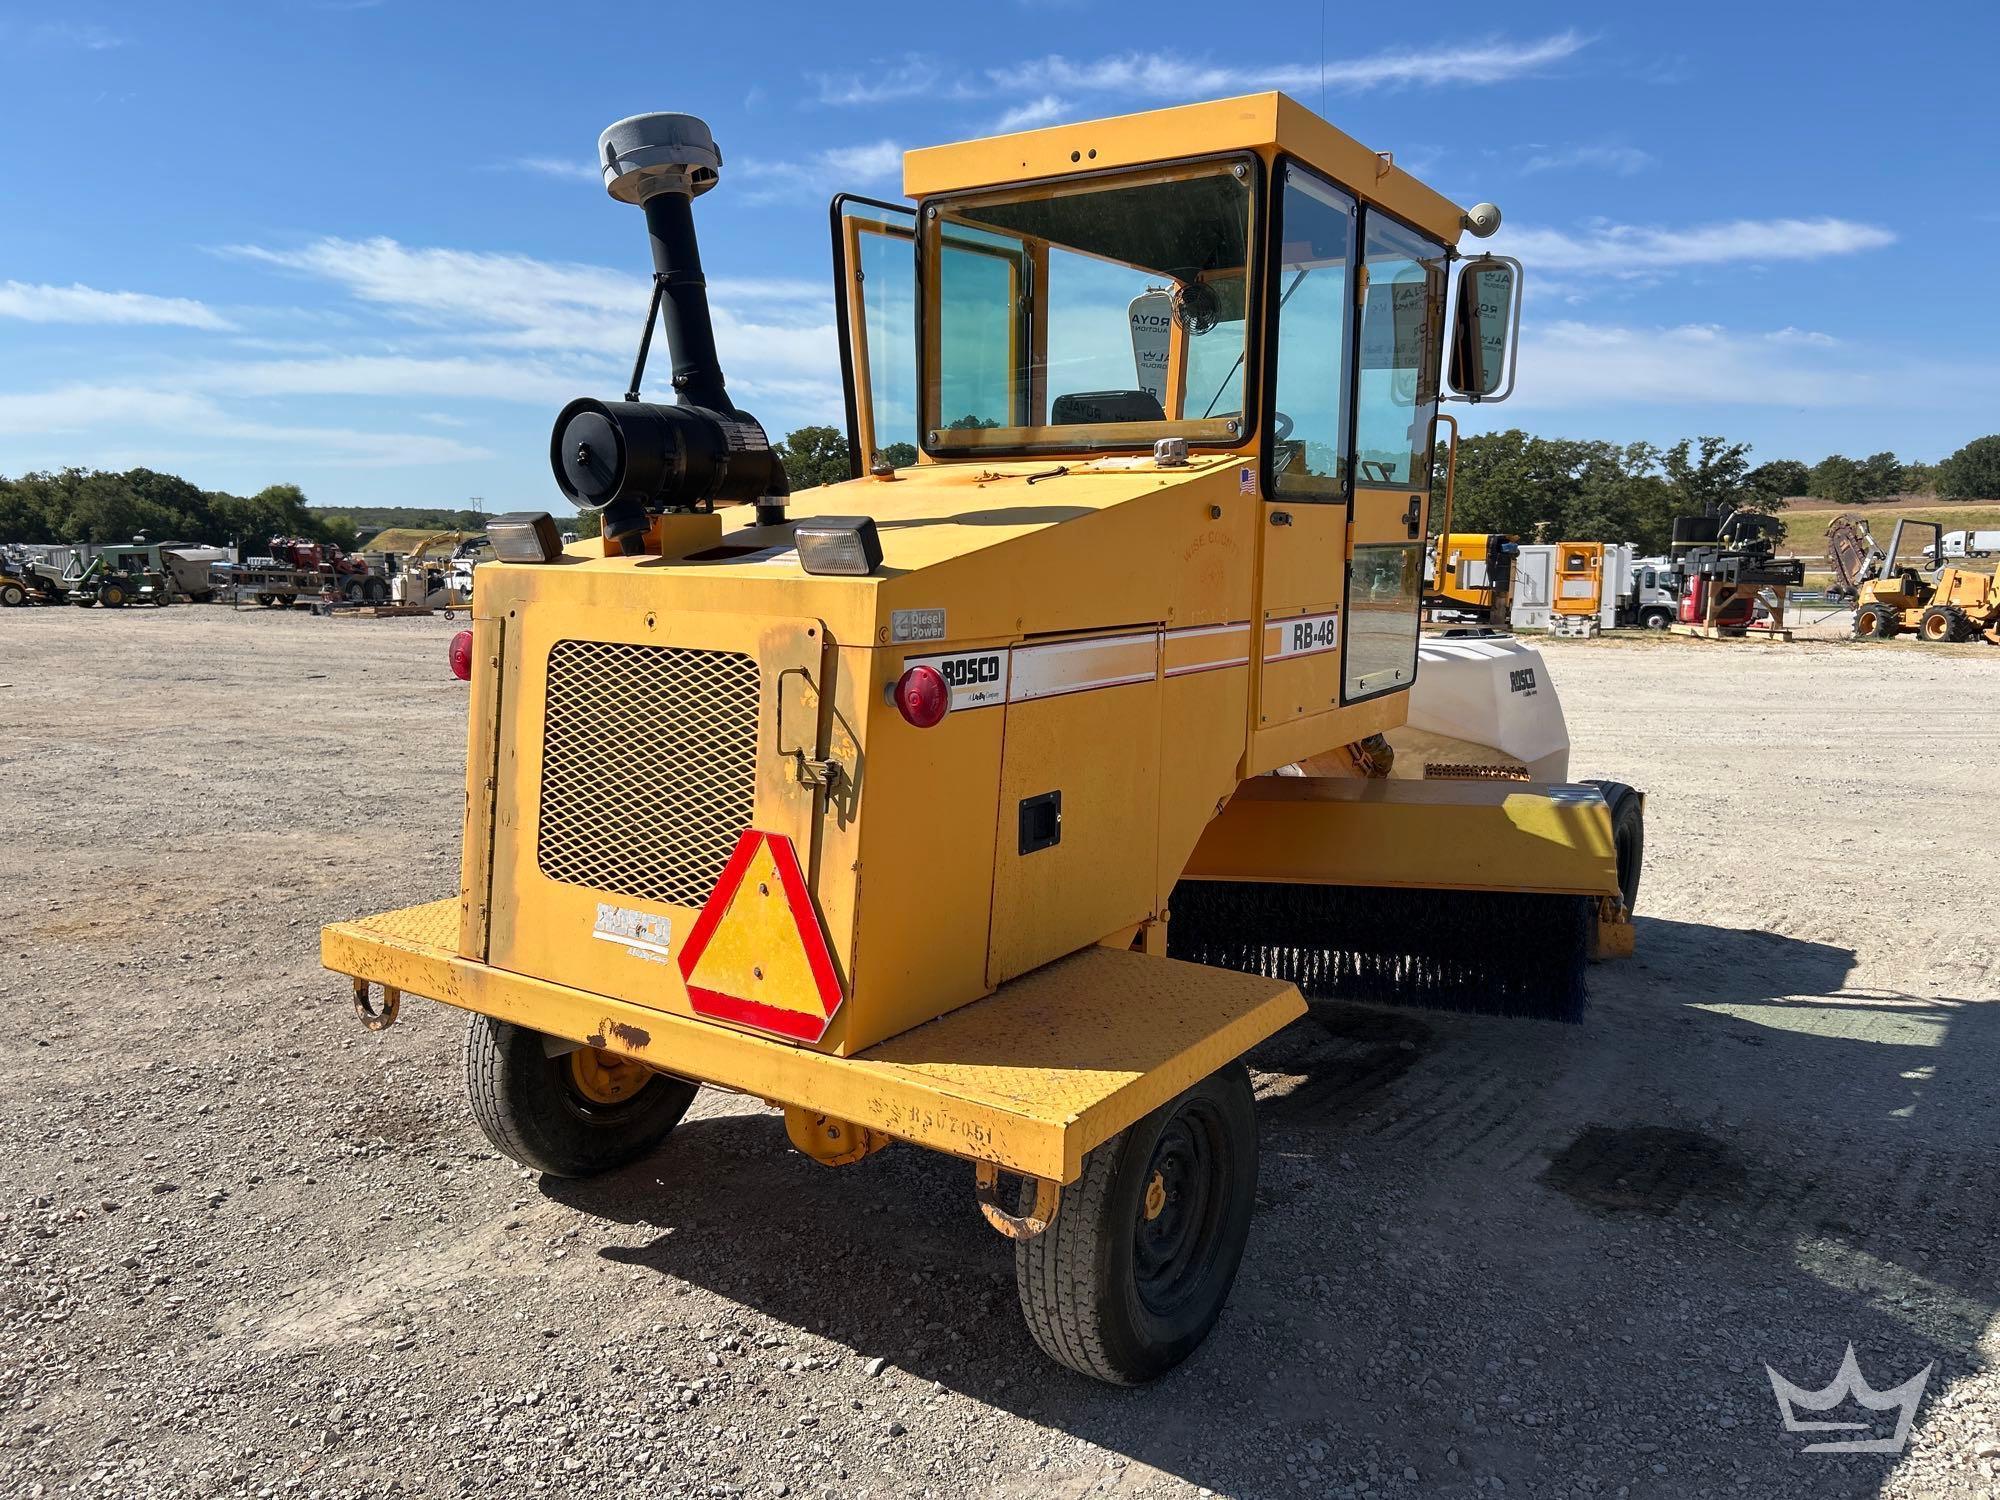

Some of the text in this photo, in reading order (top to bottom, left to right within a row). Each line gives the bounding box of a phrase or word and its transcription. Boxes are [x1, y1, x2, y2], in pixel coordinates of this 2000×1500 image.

[911, 613, 942, 625] Diesel
[911, 626, 943, 638] Power
[1293, 619, 1335, 651] RB-48
[941, 655, 1000, 687] ROSCO
